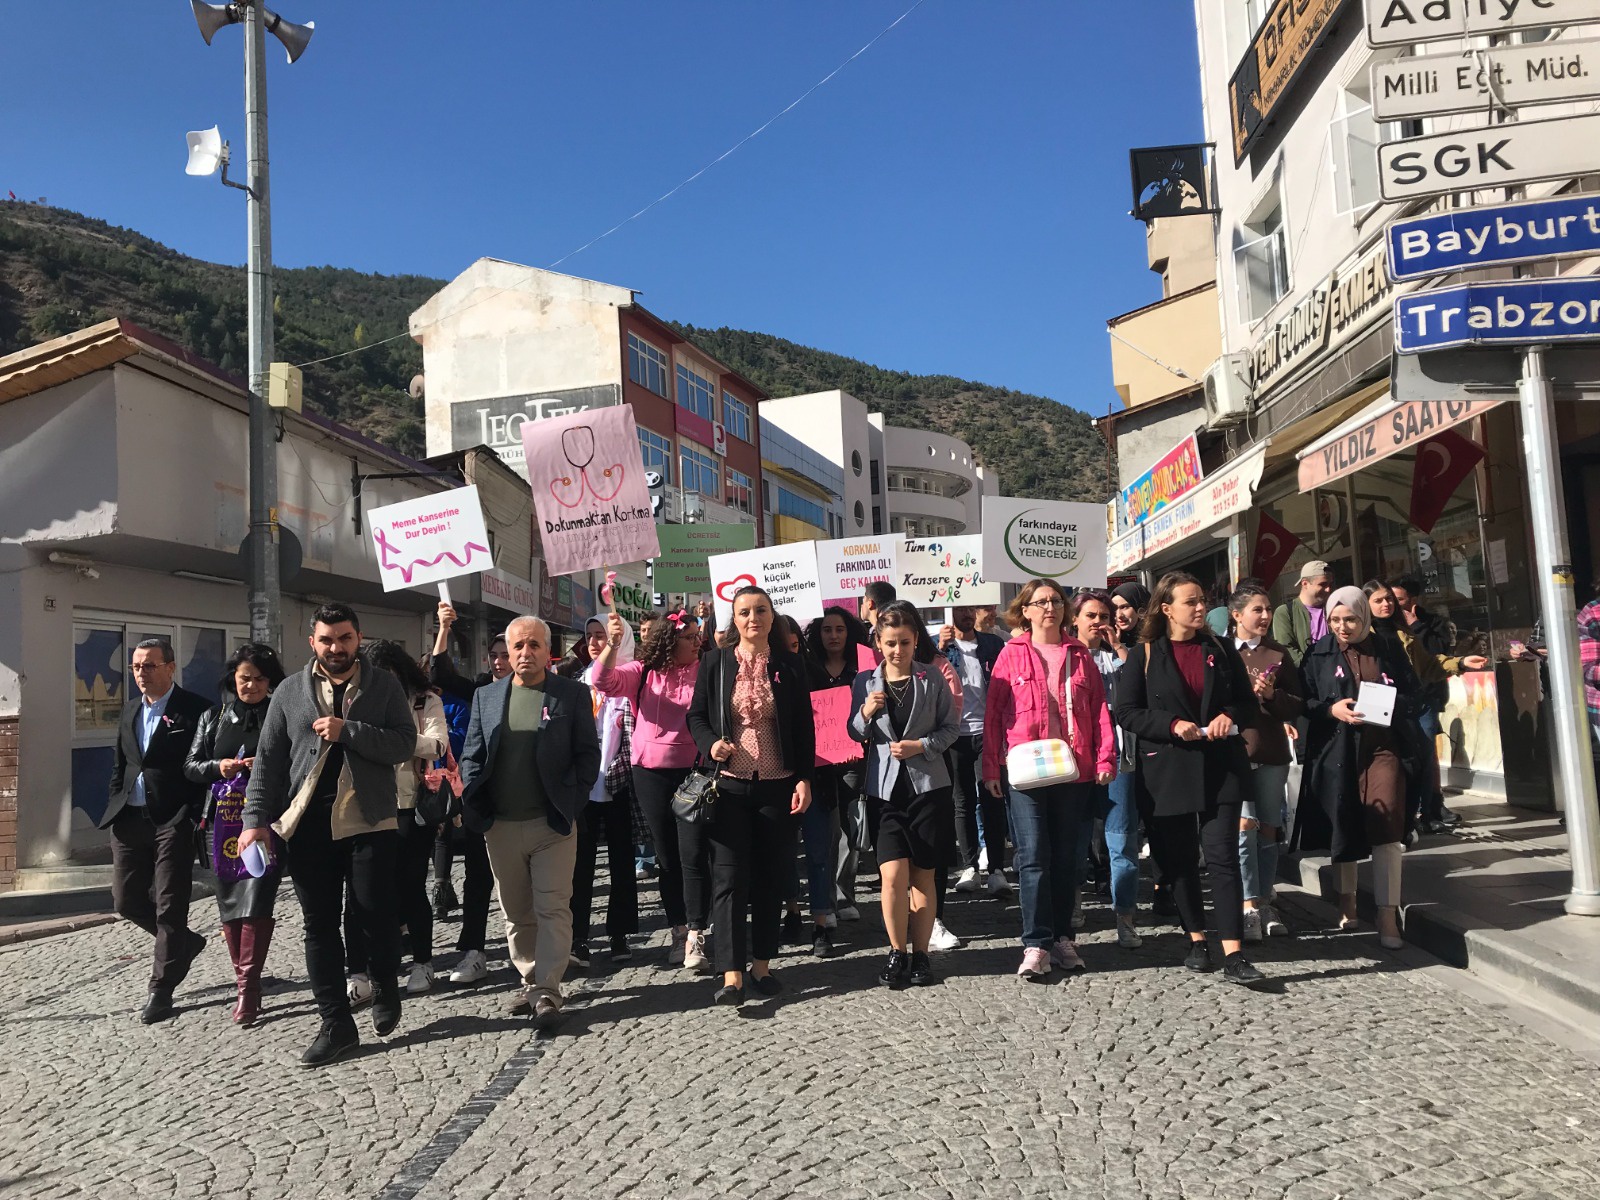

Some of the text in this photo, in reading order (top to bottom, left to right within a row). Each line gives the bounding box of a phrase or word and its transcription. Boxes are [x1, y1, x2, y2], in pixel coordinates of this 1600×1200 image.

[1384, 70, 1438, 98] Milli
[1526, 54, 1589, 82] Müd.
[1390, 138, 1514, 185] SGK
[1401, 206, 1600, 261] Bayburt
[1330, 250, 1388, 330] EKMEK
[1323, 423, 1377, 476] YILDIZ
[1151, 454, 1188, 500] OYUNCAK
[391, 507, 460, 529] Meme Kanserine
[545, 510, 612, 534] Dokunmaktan
[612, 504, 650, 523] Korkma
[1018, 518, 1078, 533] farkındayız
[405, 530, 420, 539] Dur
[421, 523, 446, 536] Deyin
[687, 531, 721, 539] ÜCRETSİZ
[904, 540, 926, 553] Tüm
[1019, 533, 1077, 548] KANSERİ
[843, 543, 881, 556] KORKMA!
[1018, 548, 1077, 560] YENECEĞİZ
[762, 560, 796, 571] Kanser,
[836, 558, 891, 573] FARKINDA OL!
[764, 572, 791, 583] küçük
[840, 577, 857, 591] GEÇ
[902, 573, 950, 586] Kansere
[766, 580, 816, 595] şikayetlerle
[773, 596, 797, 606] aşlar.
